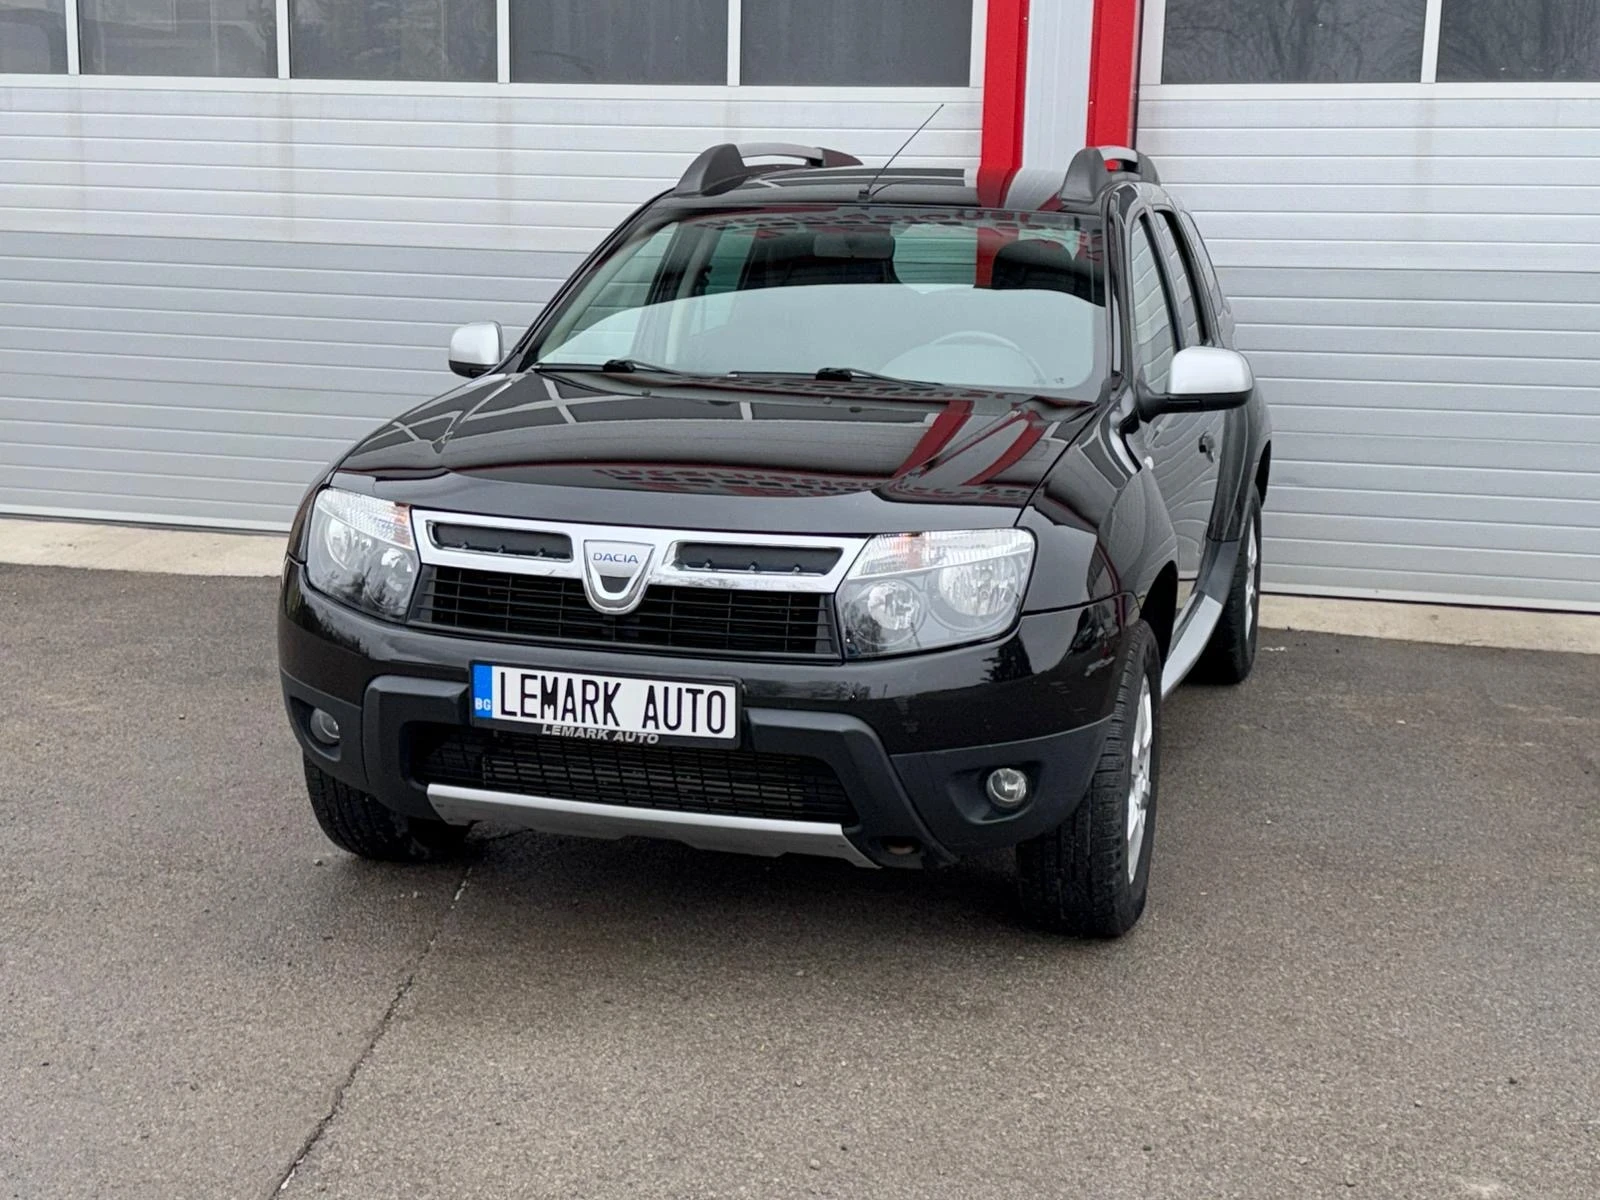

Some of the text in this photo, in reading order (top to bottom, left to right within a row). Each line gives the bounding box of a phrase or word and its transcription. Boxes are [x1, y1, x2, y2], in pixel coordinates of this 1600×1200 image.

[593, 552, 639, 564] DACIA
[475, 698, 492, 710] BG
[500, 672, 726, 734] LEMARK AUTO
[541, 724, 659, 744] LEMARK AUTO
